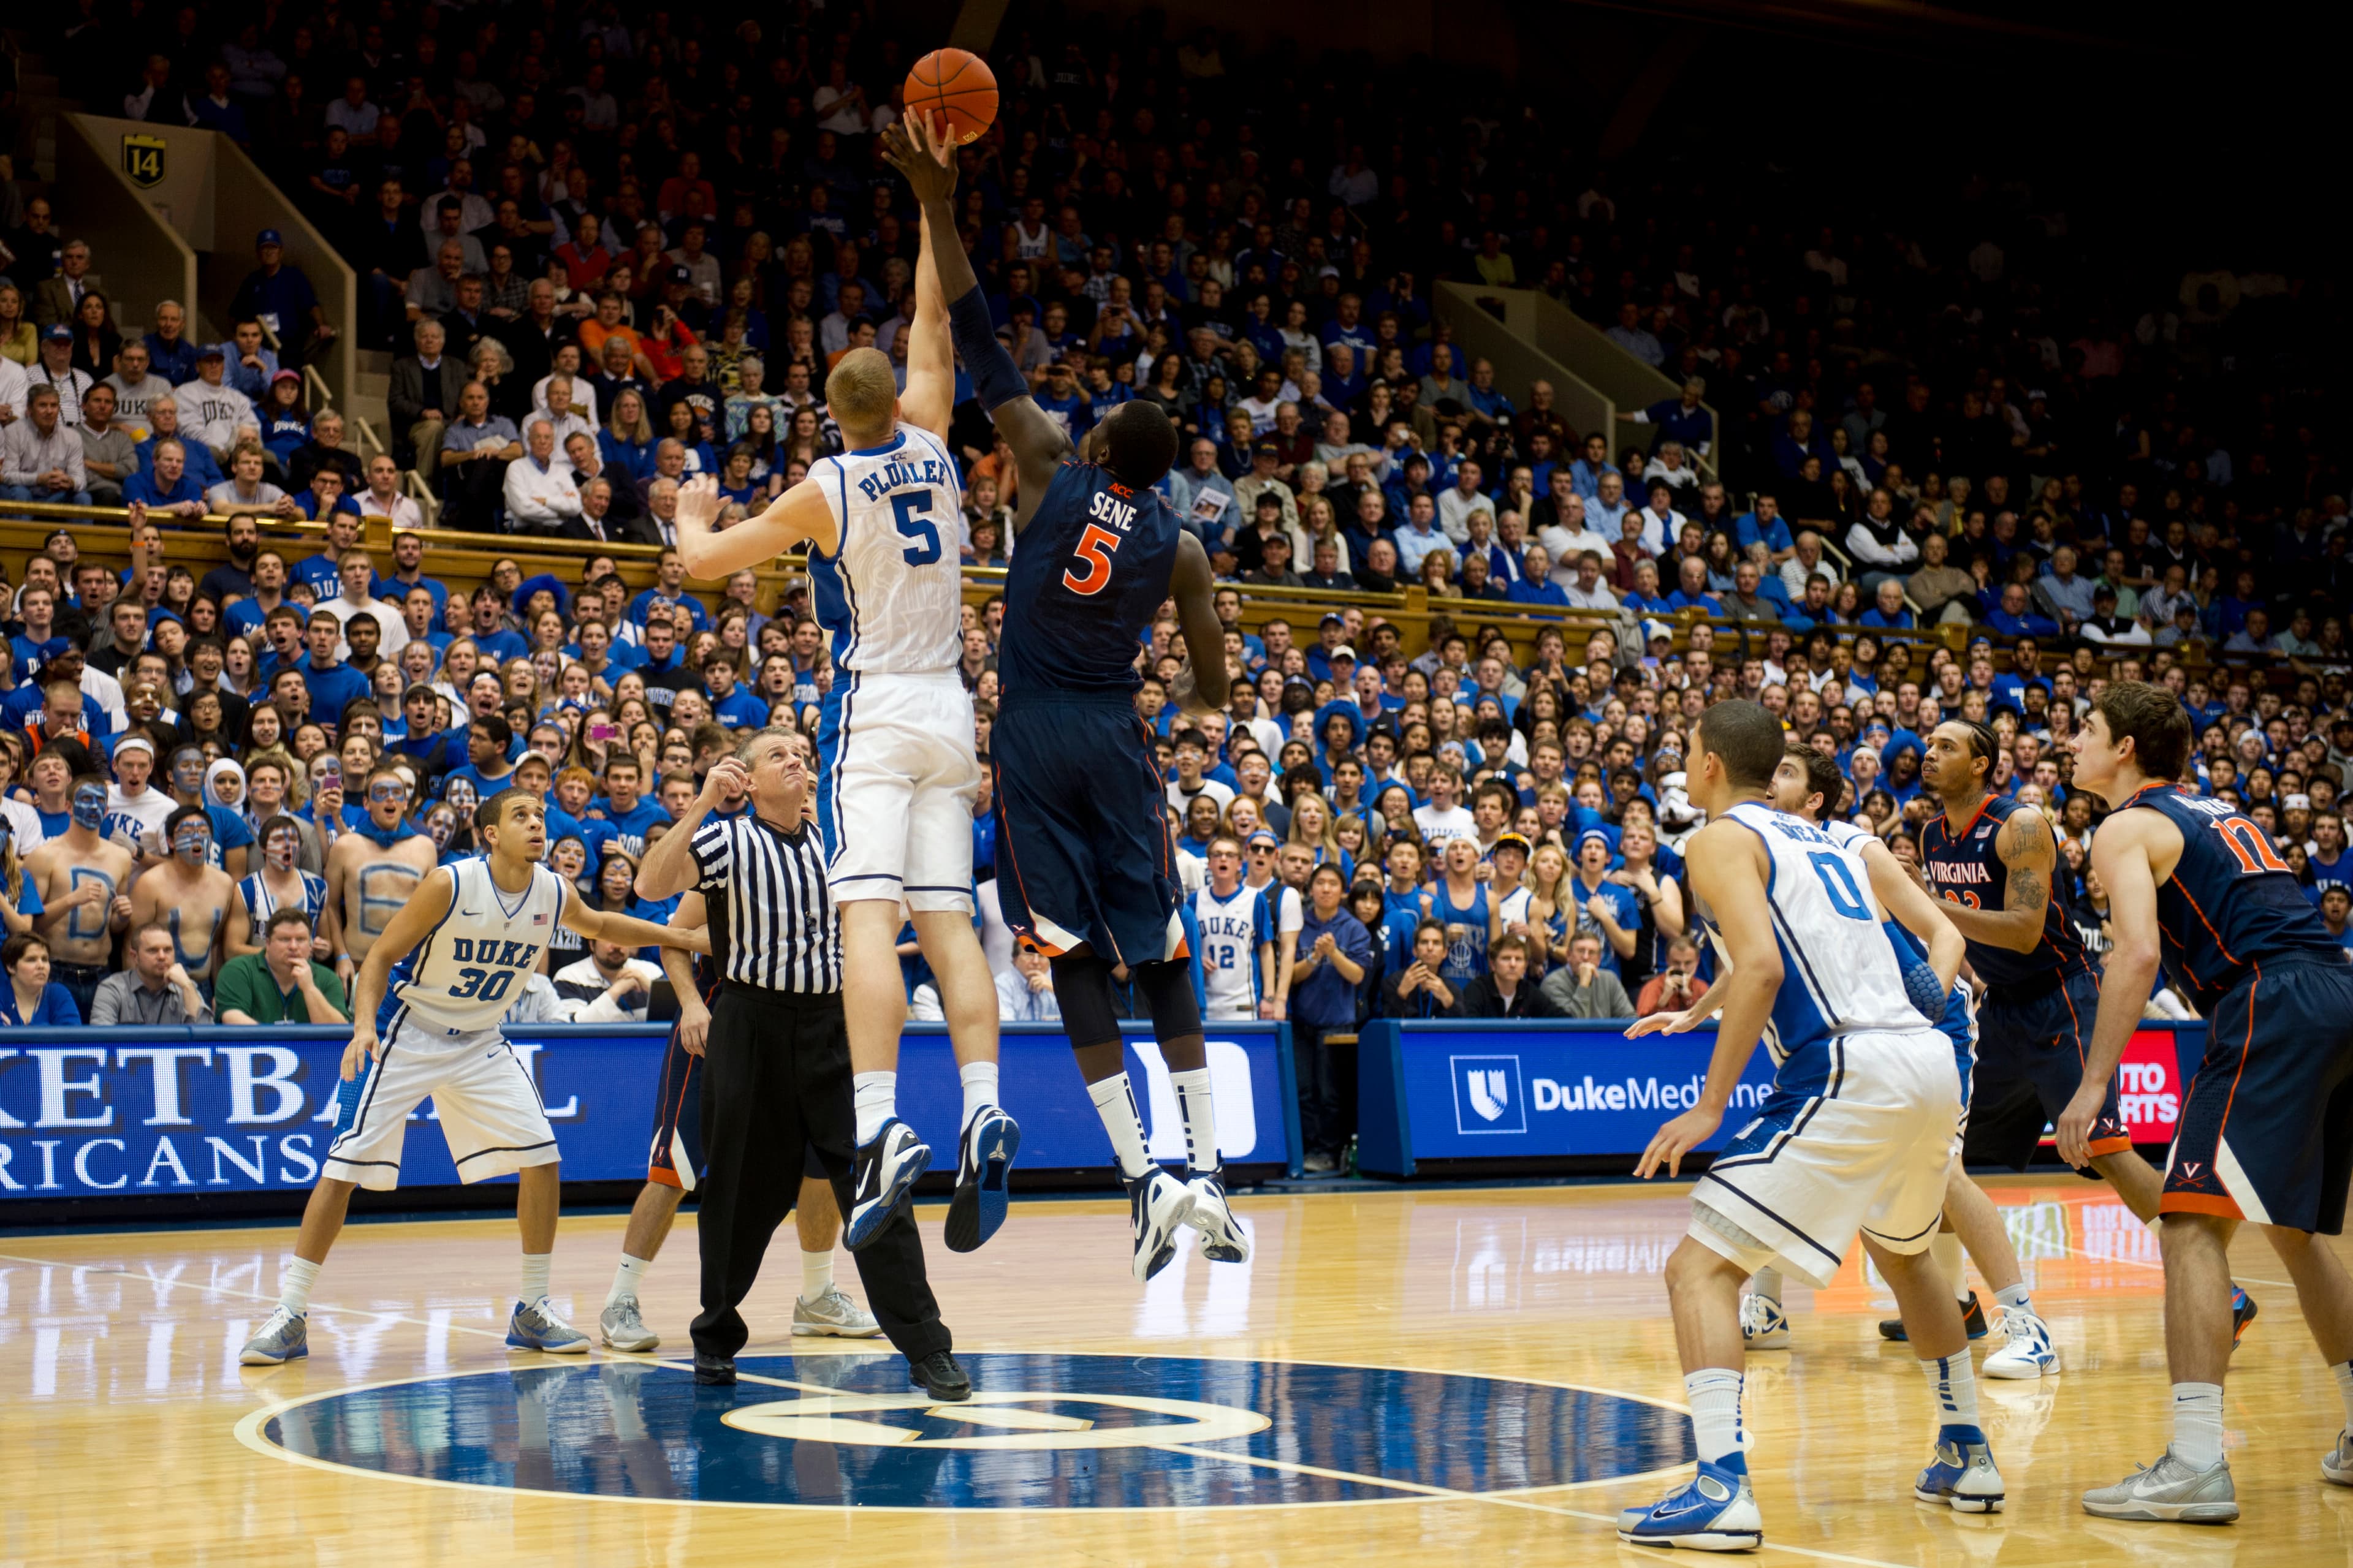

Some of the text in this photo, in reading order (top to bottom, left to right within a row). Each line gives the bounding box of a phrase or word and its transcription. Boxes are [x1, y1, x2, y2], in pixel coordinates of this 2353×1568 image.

[129, 147, 159, 178] 14
[1108, 482, 1134, 499] ACC
[890, 489, 941, 567] 5
[1089, 491, 1138, 532] SENE
[1062, 522, 1122, 596] 5
[2210, 816, 2293, 874] 12
[1806, 850, 1874, 921] 0
[1929, 860, 1993, 884] VIRGINIA
[1198, 917, 1249, 939] DUKE
[453, 937, 539, 969] DUKE
[1209, 944, 1235, 969] 12
[448, 968, 516, 1002] 30
